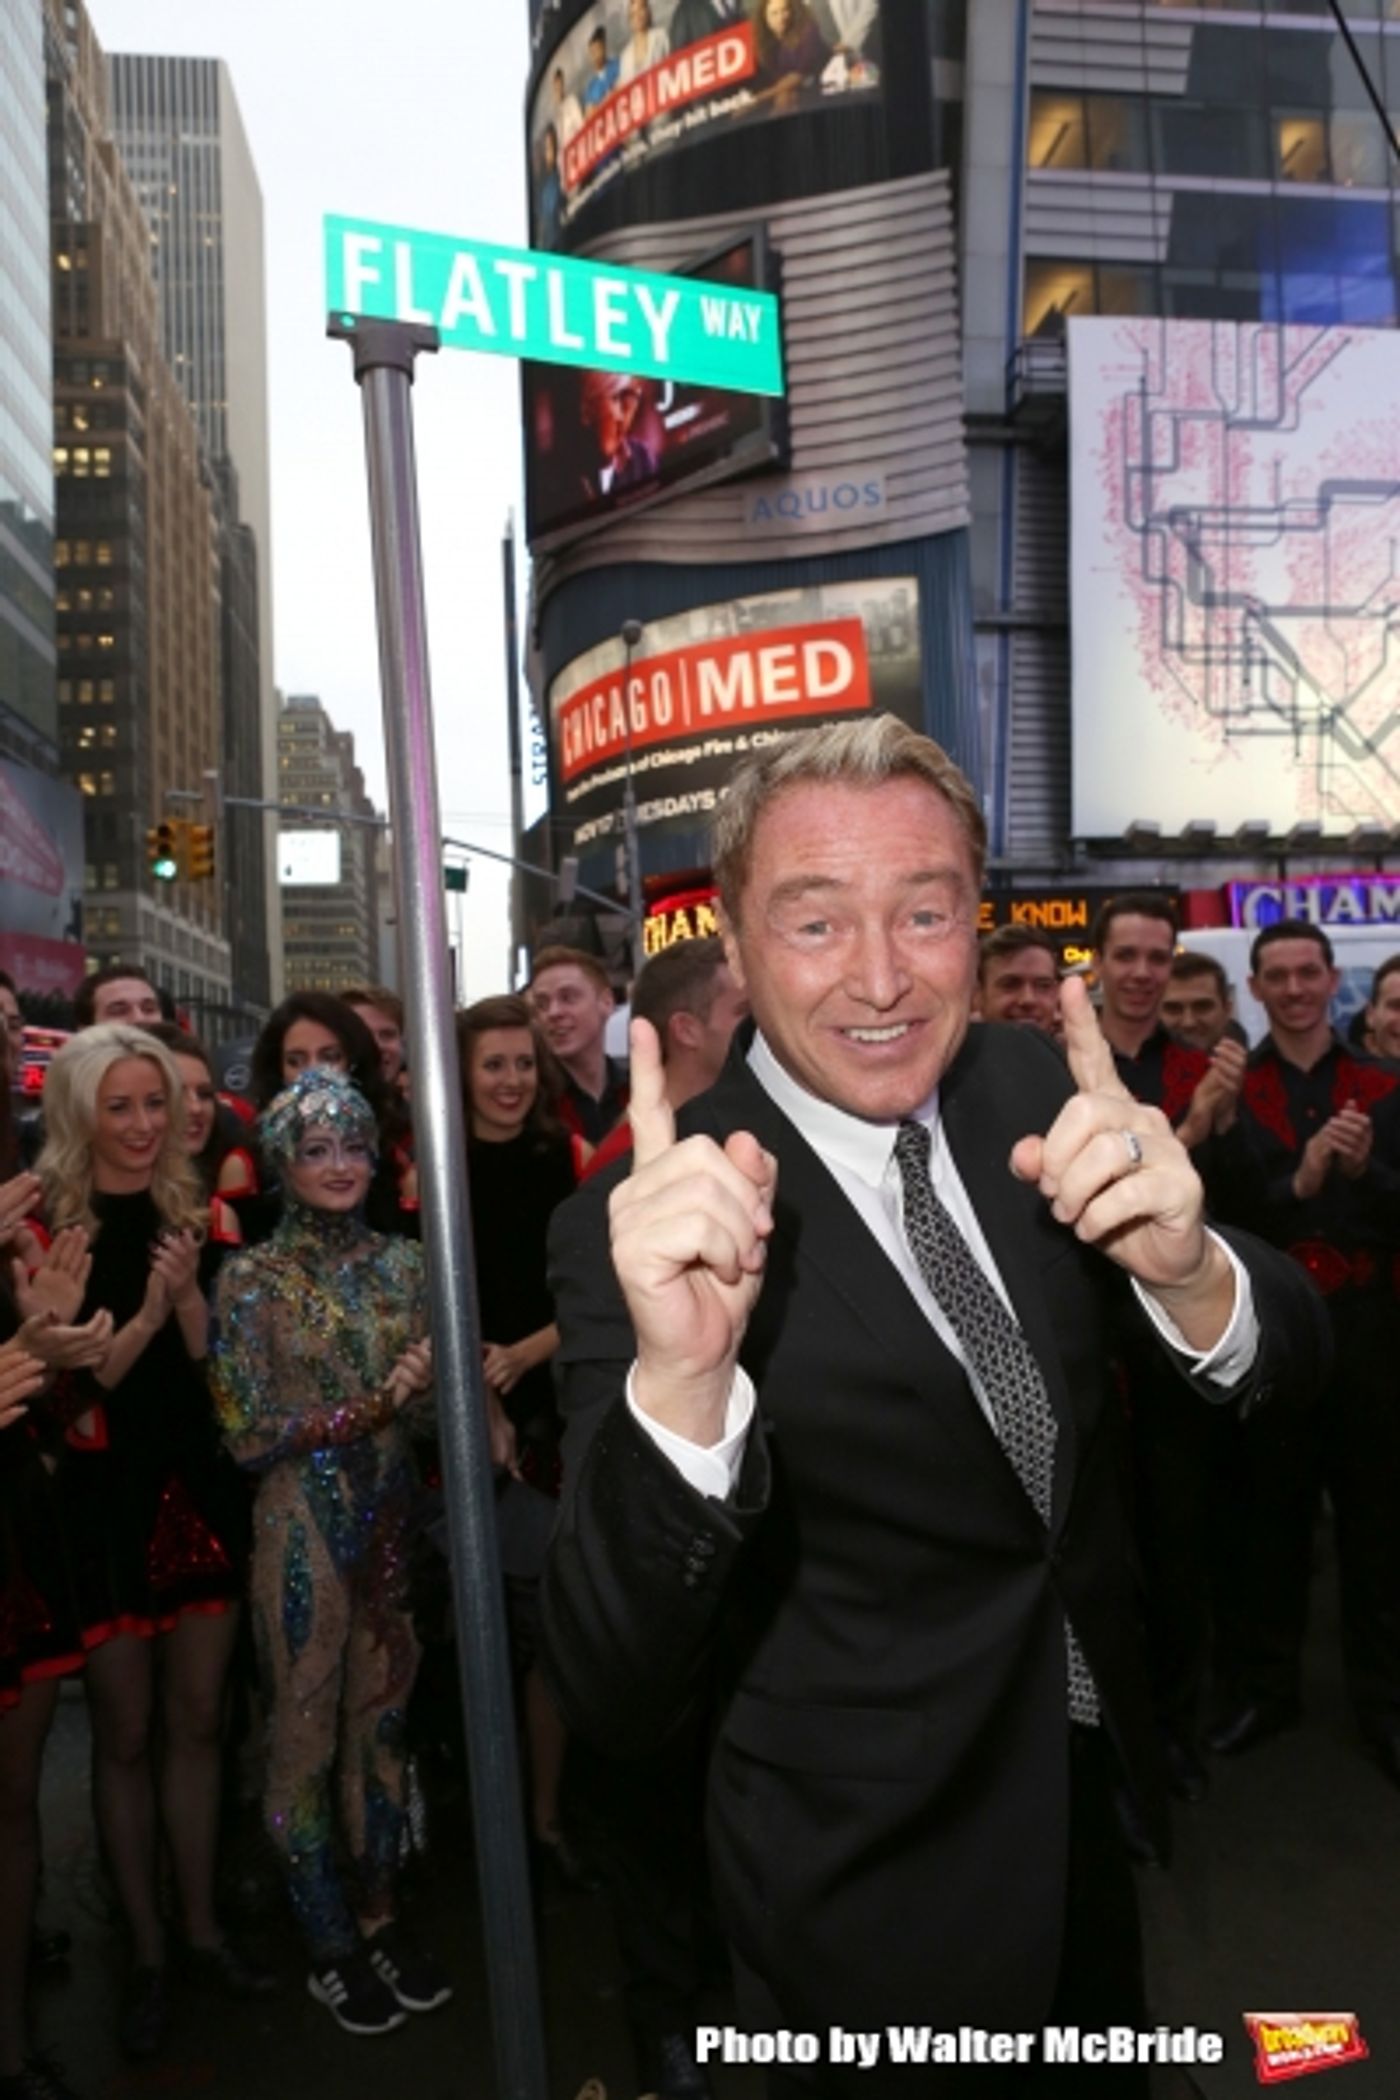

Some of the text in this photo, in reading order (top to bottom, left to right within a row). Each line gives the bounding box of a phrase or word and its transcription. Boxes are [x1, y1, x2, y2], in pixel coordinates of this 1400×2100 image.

[566, 83, 646, 183] CHICAGO
[656, 37, 747, 107] MED
[821, 54, 849, 95] 4
[341, 230, 764, 365] FLATLEY WAY
[751, 481, 884, 522] AQUOS
[562, 639, 855, 769] CHICAGO MED
[1011, 898, 1088, 929] KNOW
